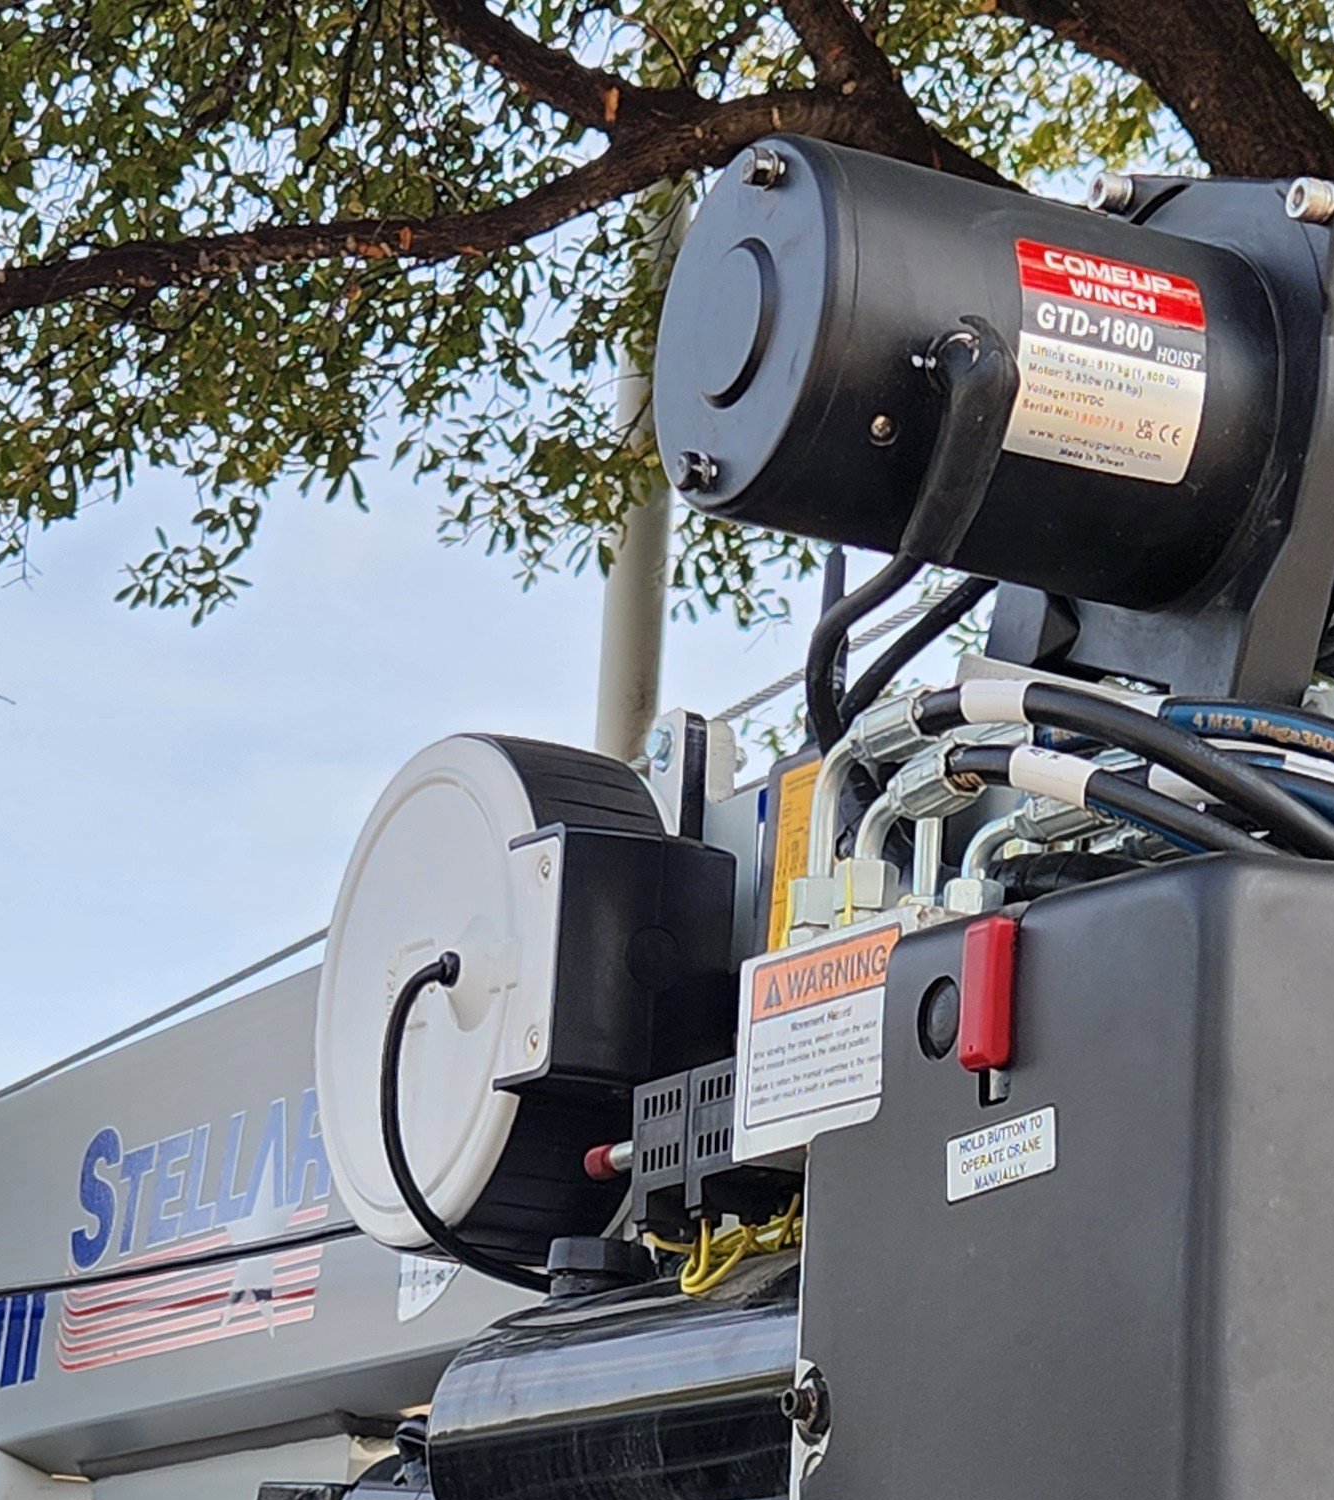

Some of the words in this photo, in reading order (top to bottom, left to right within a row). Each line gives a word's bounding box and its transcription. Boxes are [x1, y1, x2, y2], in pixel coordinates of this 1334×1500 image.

[1044, 251, 1172, 294] COMEUP
[1068, 278, 1157, 314] WINCH
[1037, 302, 1154, 352] GTD-1800
[1156, 345, 1203, 369] HOIST
[787, 944, 888, 1001] WARNING
[959, 1133, 985, 1155] HOLD
[987, 1119, 1027, 1146] BUTTON
[1030, 1114, 1043, 1131] TO
[961, 1147, 1006, 1175] OPERATE
[1007, 1135, 1042, 1159] CRANE
[71, 1087, 331, 1272] STELLAR
[974, 1161, 1027, 1190] MANUALLY
